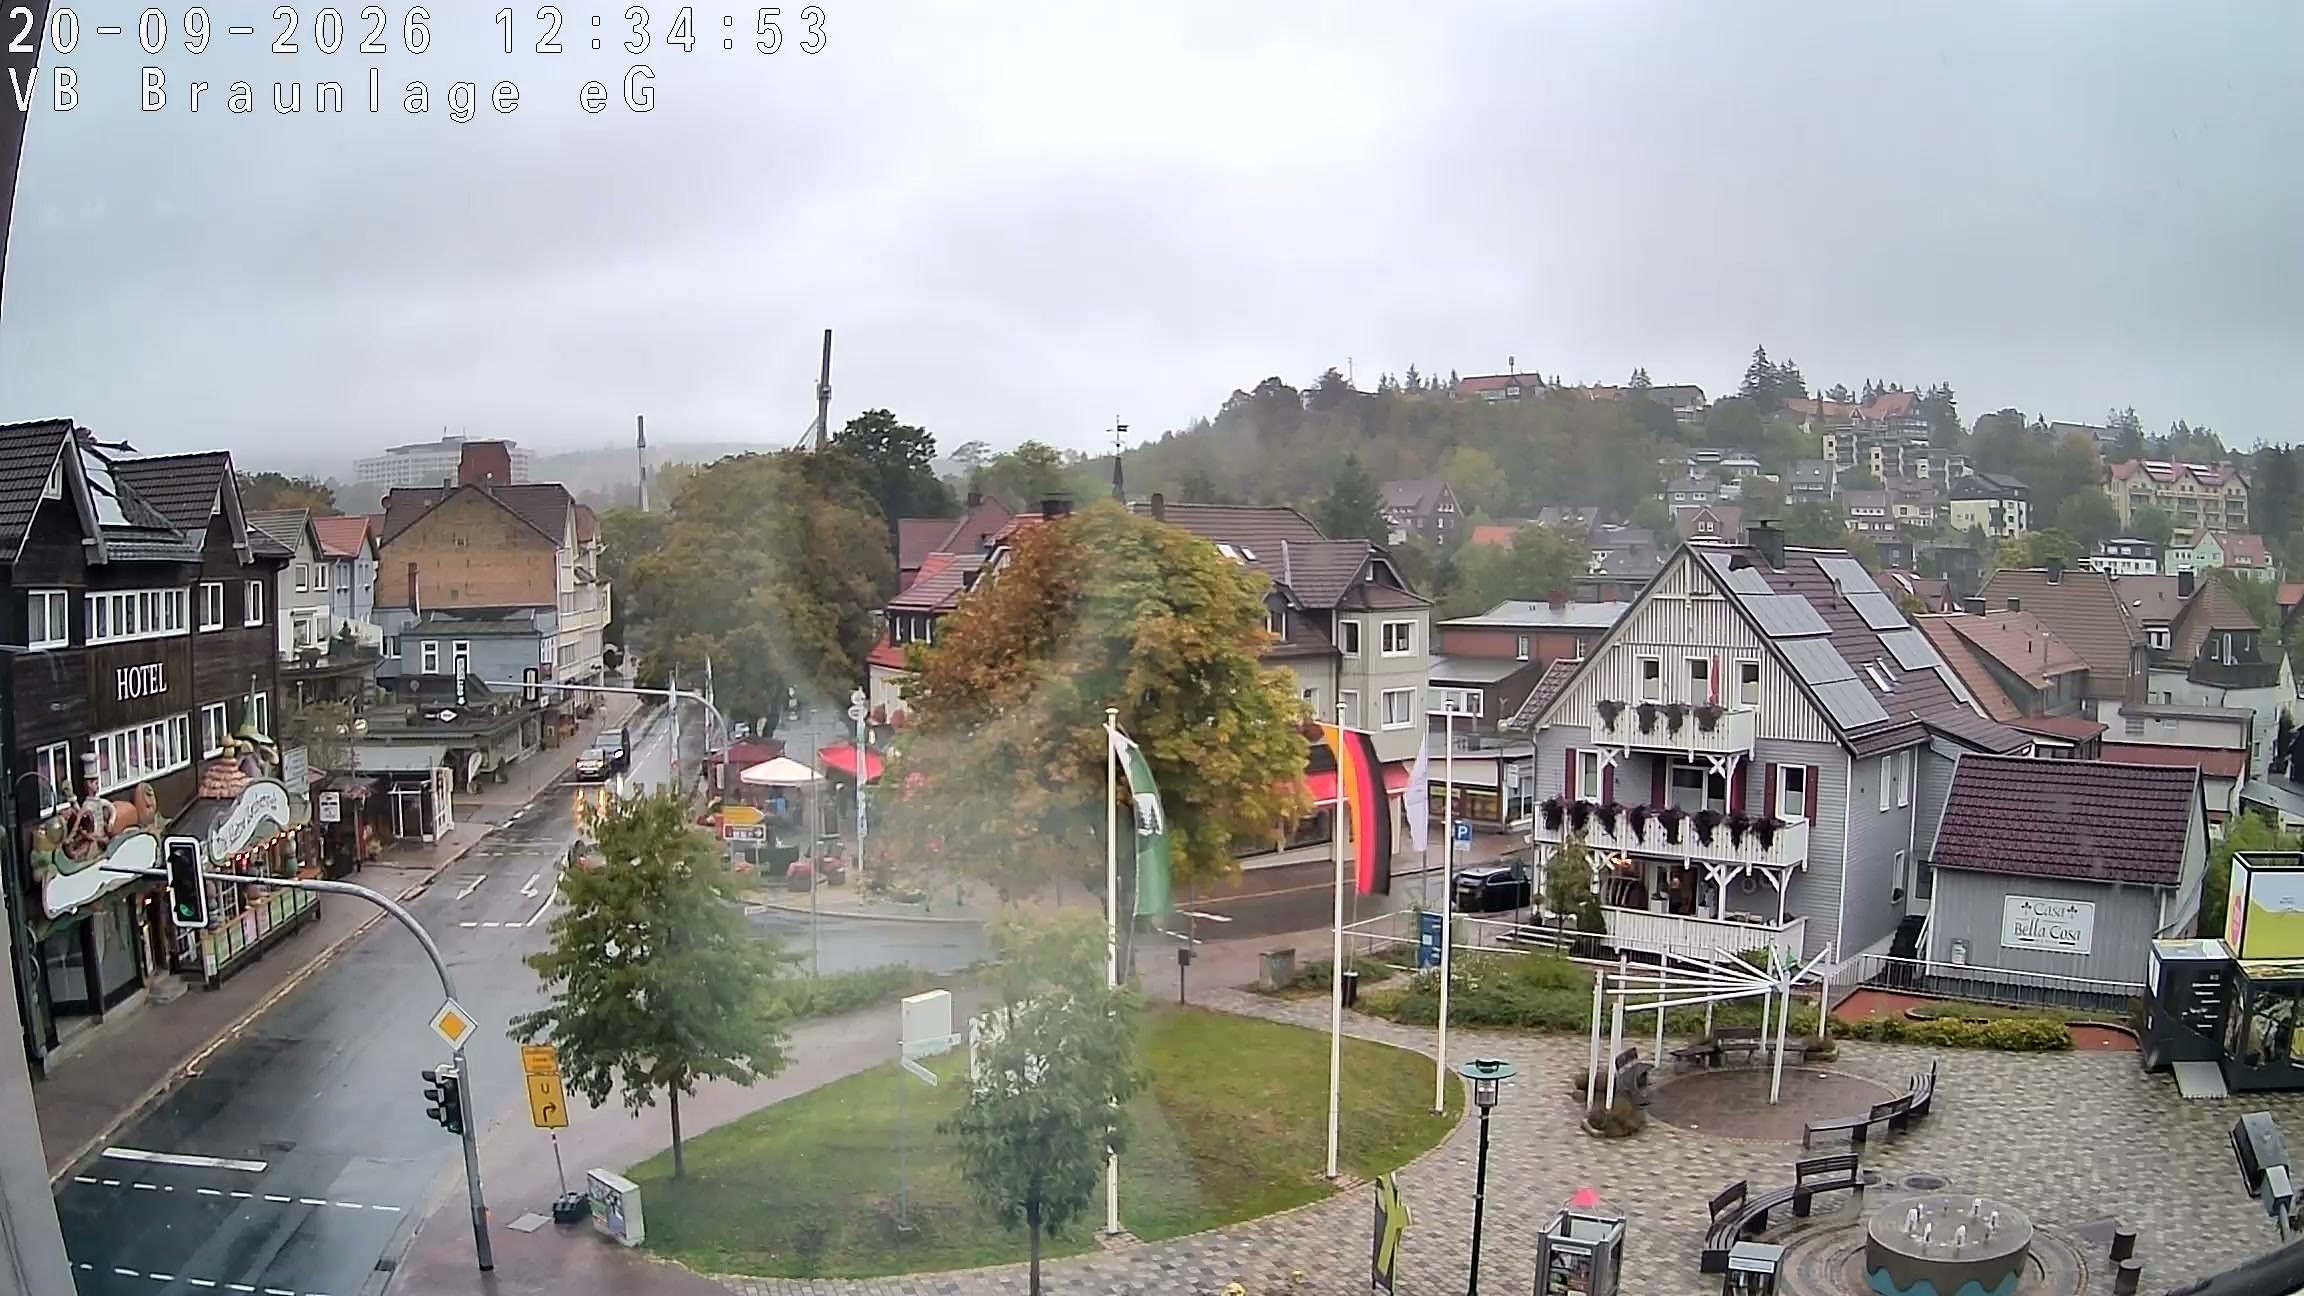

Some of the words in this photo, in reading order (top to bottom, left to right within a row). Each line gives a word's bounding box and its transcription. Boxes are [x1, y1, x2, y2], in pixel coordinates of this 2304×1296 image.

[116, 662, 168, 701] HOTEL
[1457, 825, 1469, 839] P
[2033, 902, 2066, 918] Casa
[2014, 917, 2046, 937] Bella
[540, 1083, 550, 1095] U
